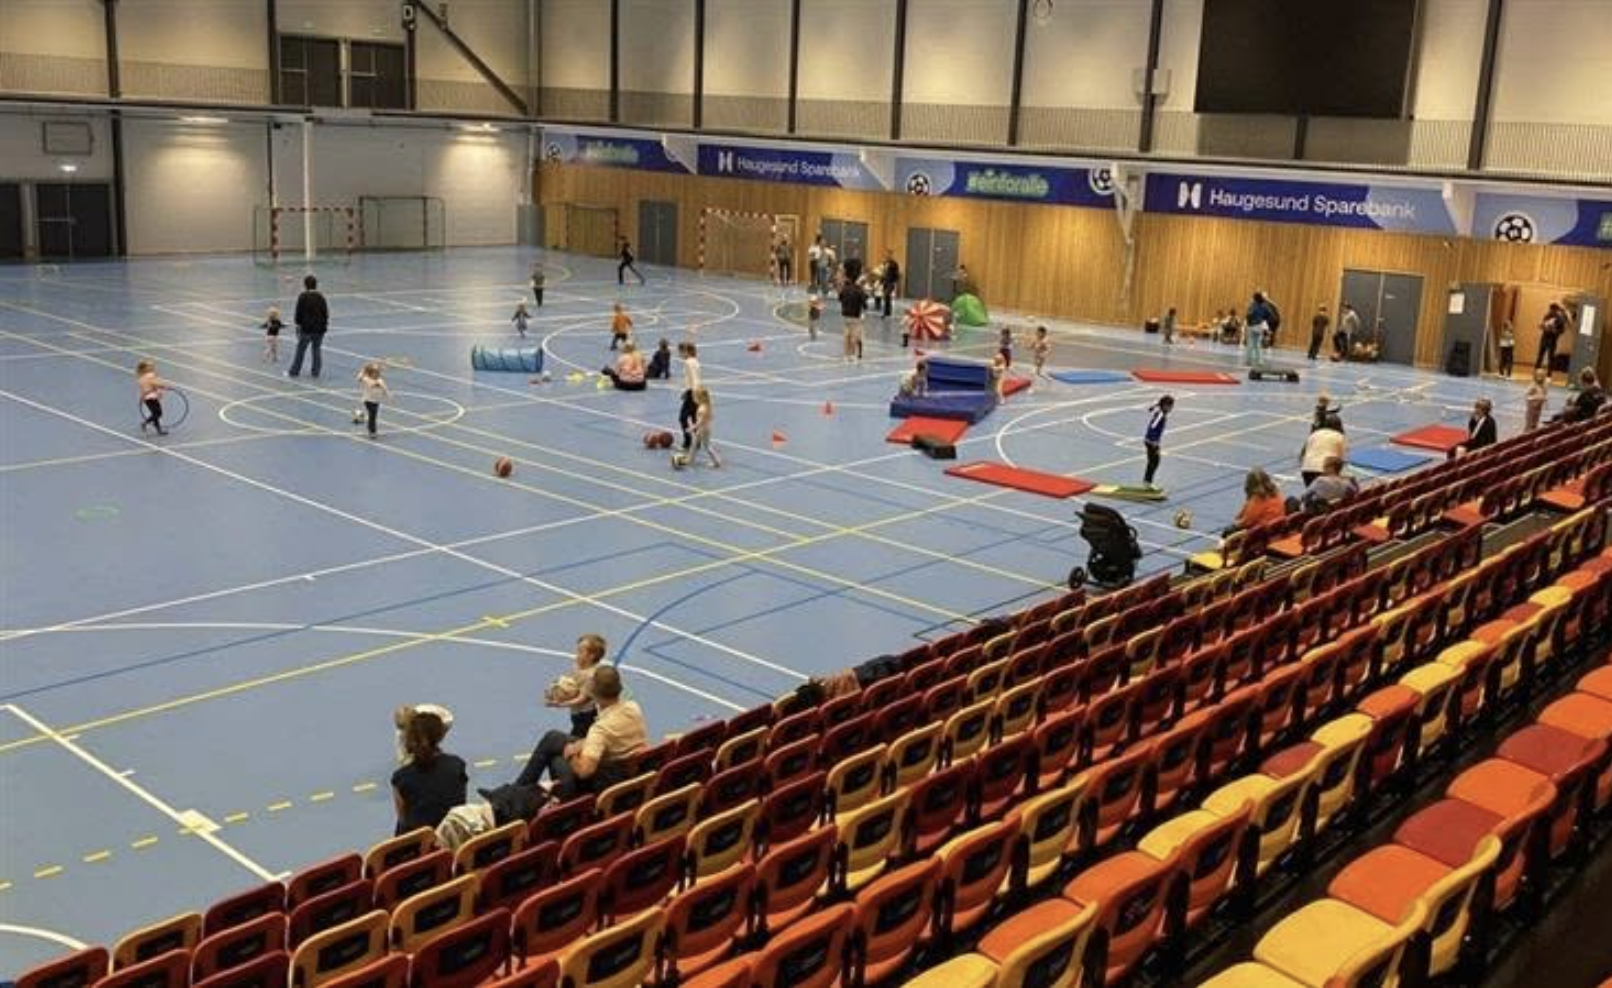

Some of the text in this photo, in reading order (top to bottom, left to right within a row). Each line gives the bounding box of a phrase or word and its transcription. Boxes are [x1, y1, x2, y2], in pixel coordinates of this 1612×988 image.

[737, 157, 798, 174] Haugesund
[1209, 188, 1415, 219] Haugesund Sparebank
